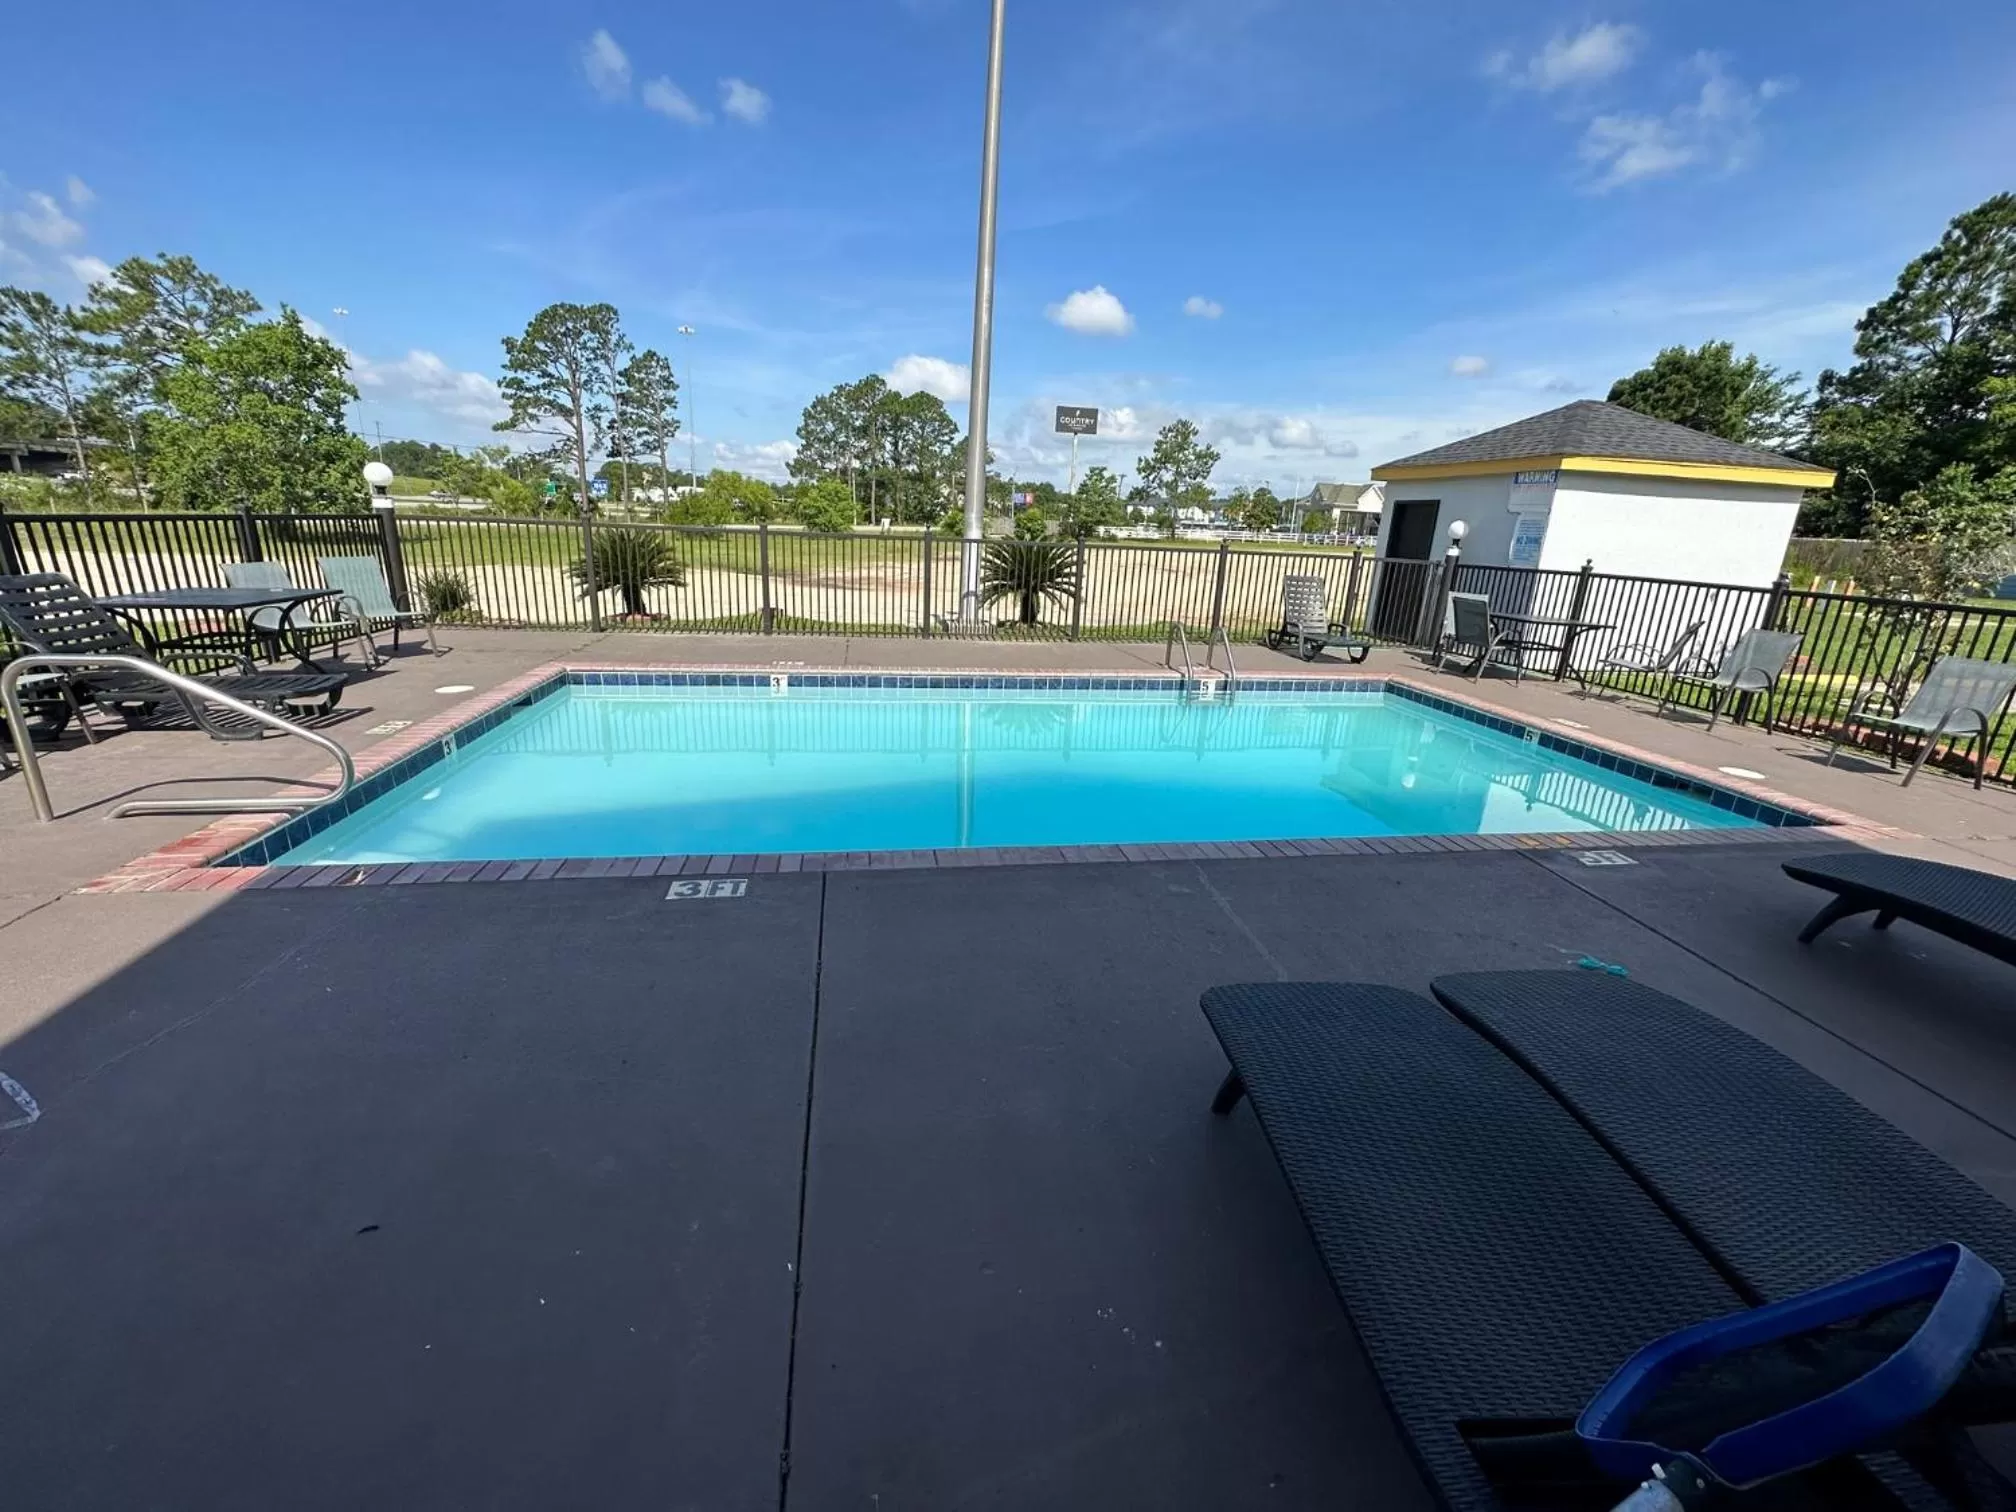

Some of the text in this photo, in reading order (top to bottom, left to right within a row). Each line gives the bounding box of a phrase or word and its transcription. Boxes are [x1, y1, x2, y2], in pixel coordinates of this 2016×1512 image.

[1060, 416, 1095, 425] COUNTRY
[1518, 470, 1556, 484] WARNING
[1525, 730, 1533, 743] 5
[445, 740, 452, 755] 3
[673, 881, 702, 897] 3
